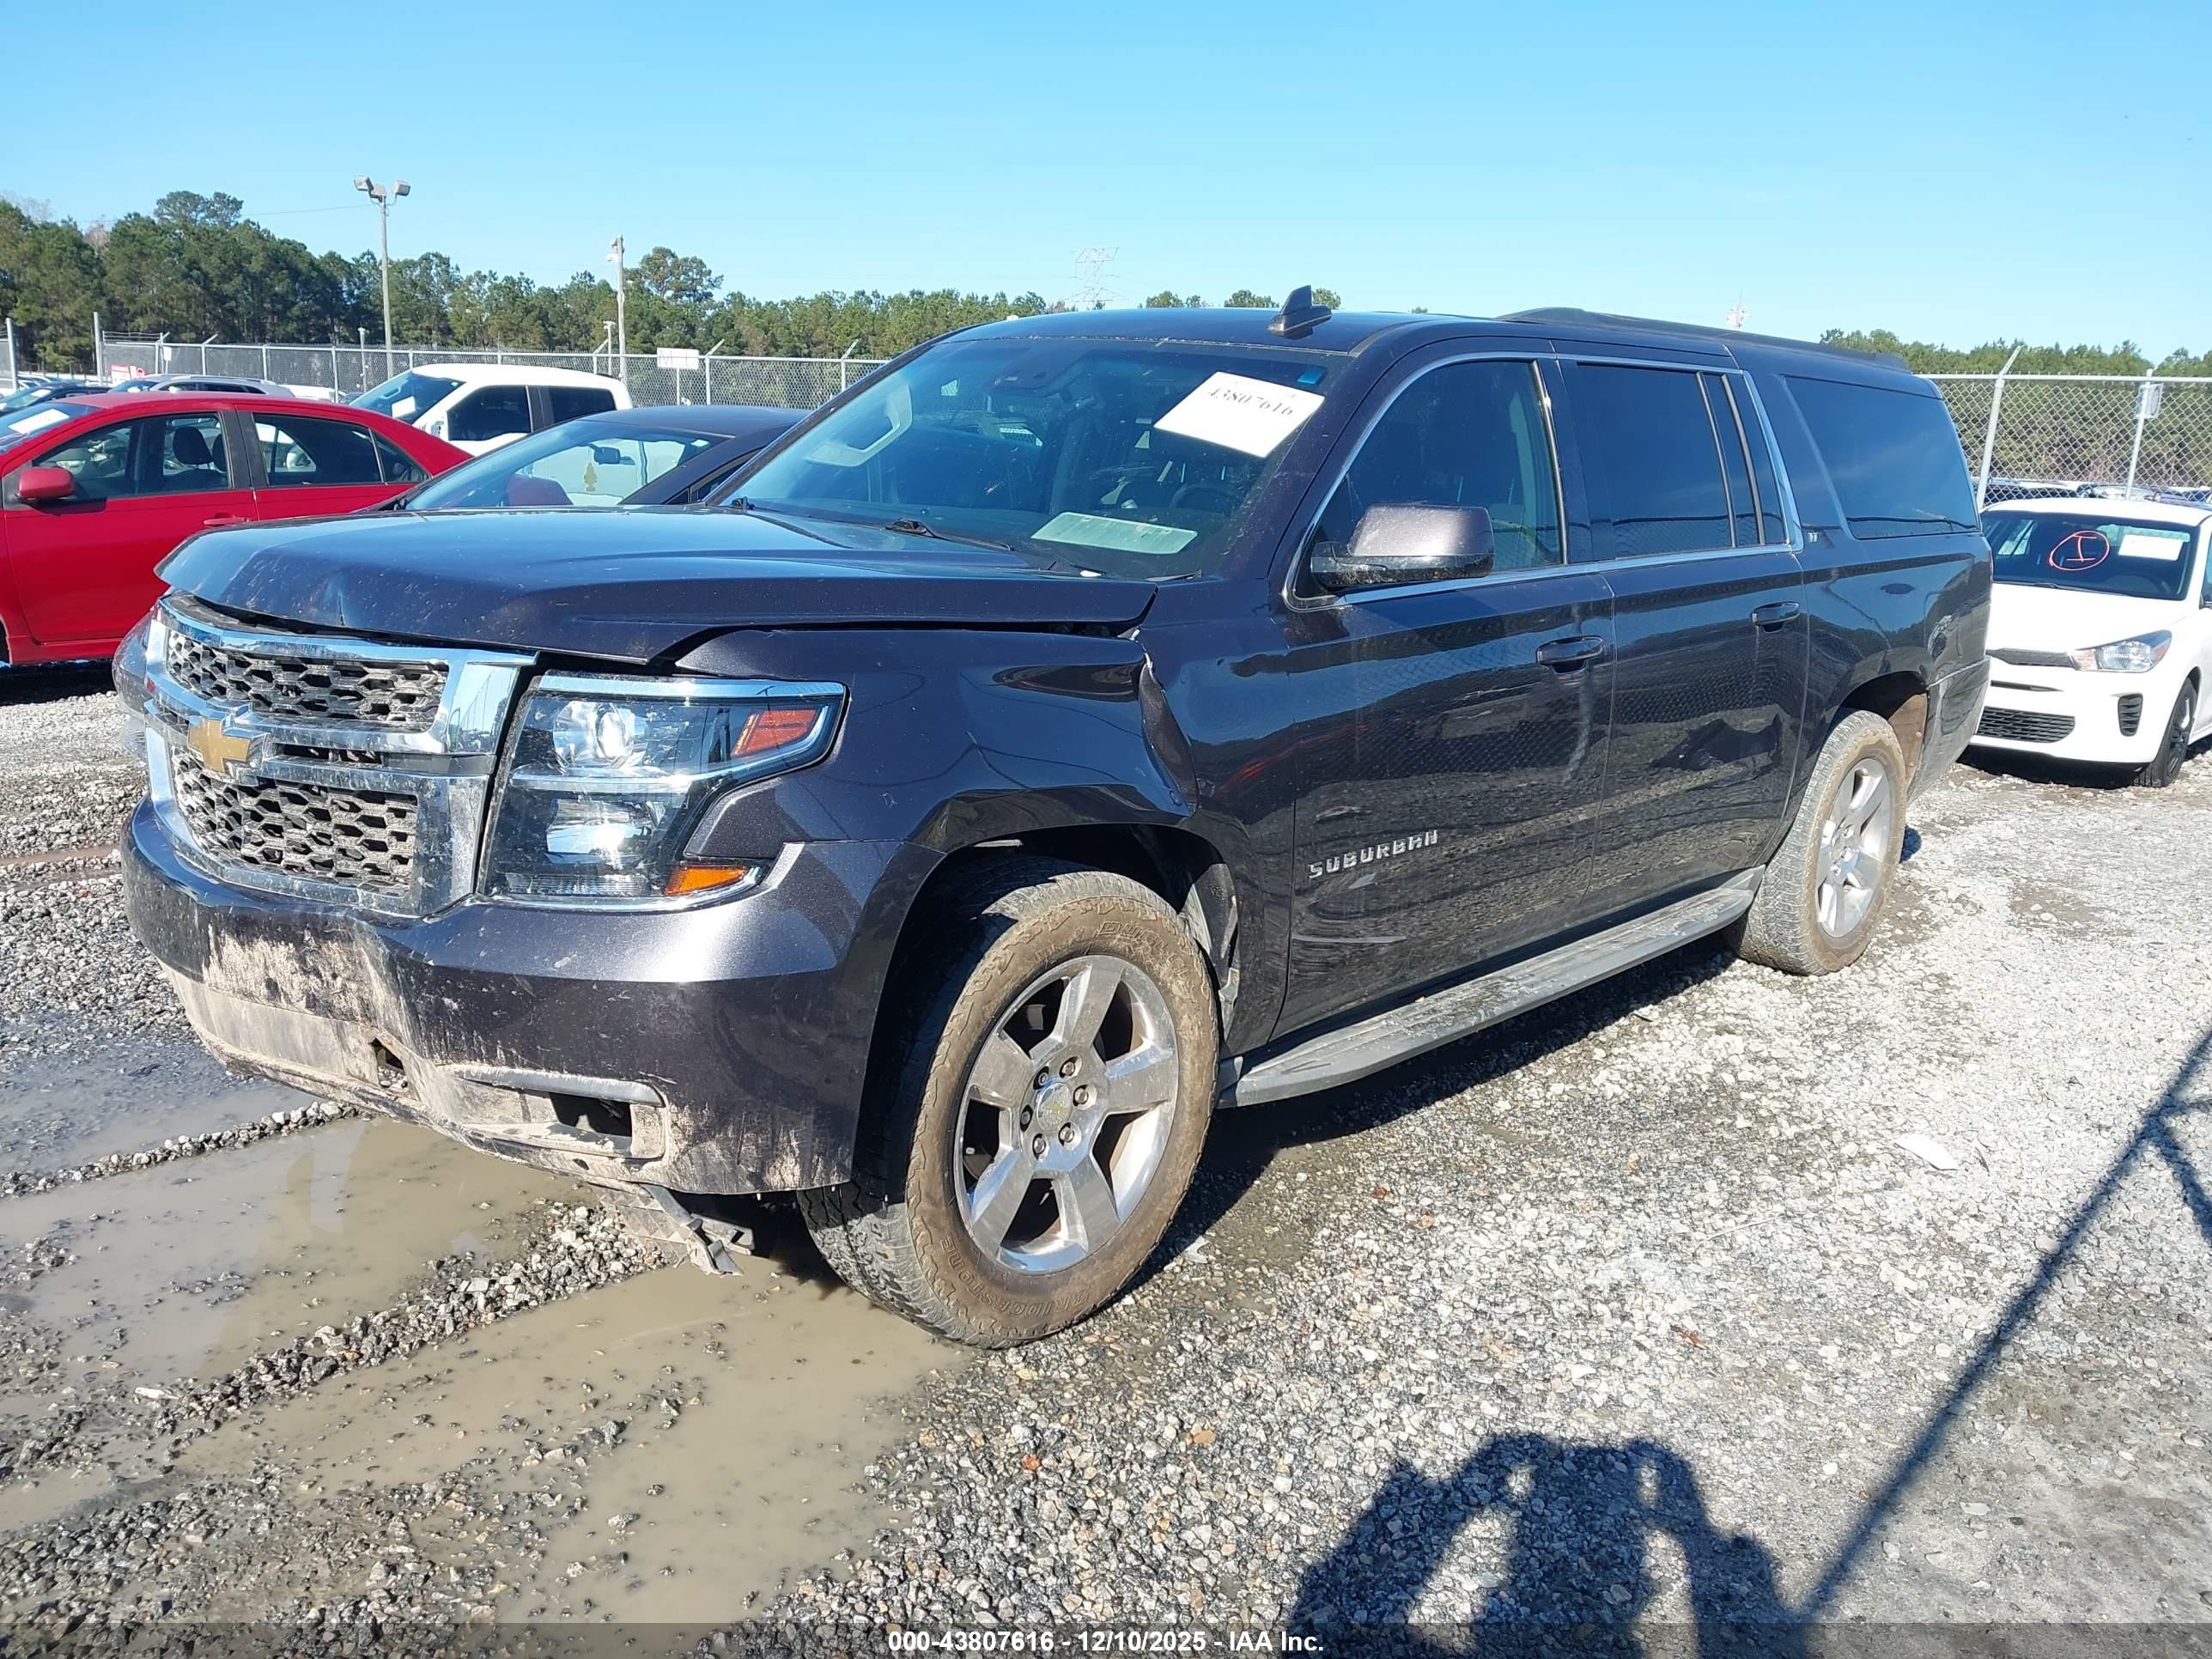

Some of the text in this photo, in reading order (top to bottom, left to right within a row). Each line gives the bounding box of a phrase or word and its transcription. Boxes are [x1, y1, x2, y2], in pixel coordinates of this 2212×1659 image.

[1206, 387, 1295, 416] 43807616
[1308, 830, 1439, 879] SUBURBAN
[939, 1236, 1091, 1317] BRIDGESTONE
